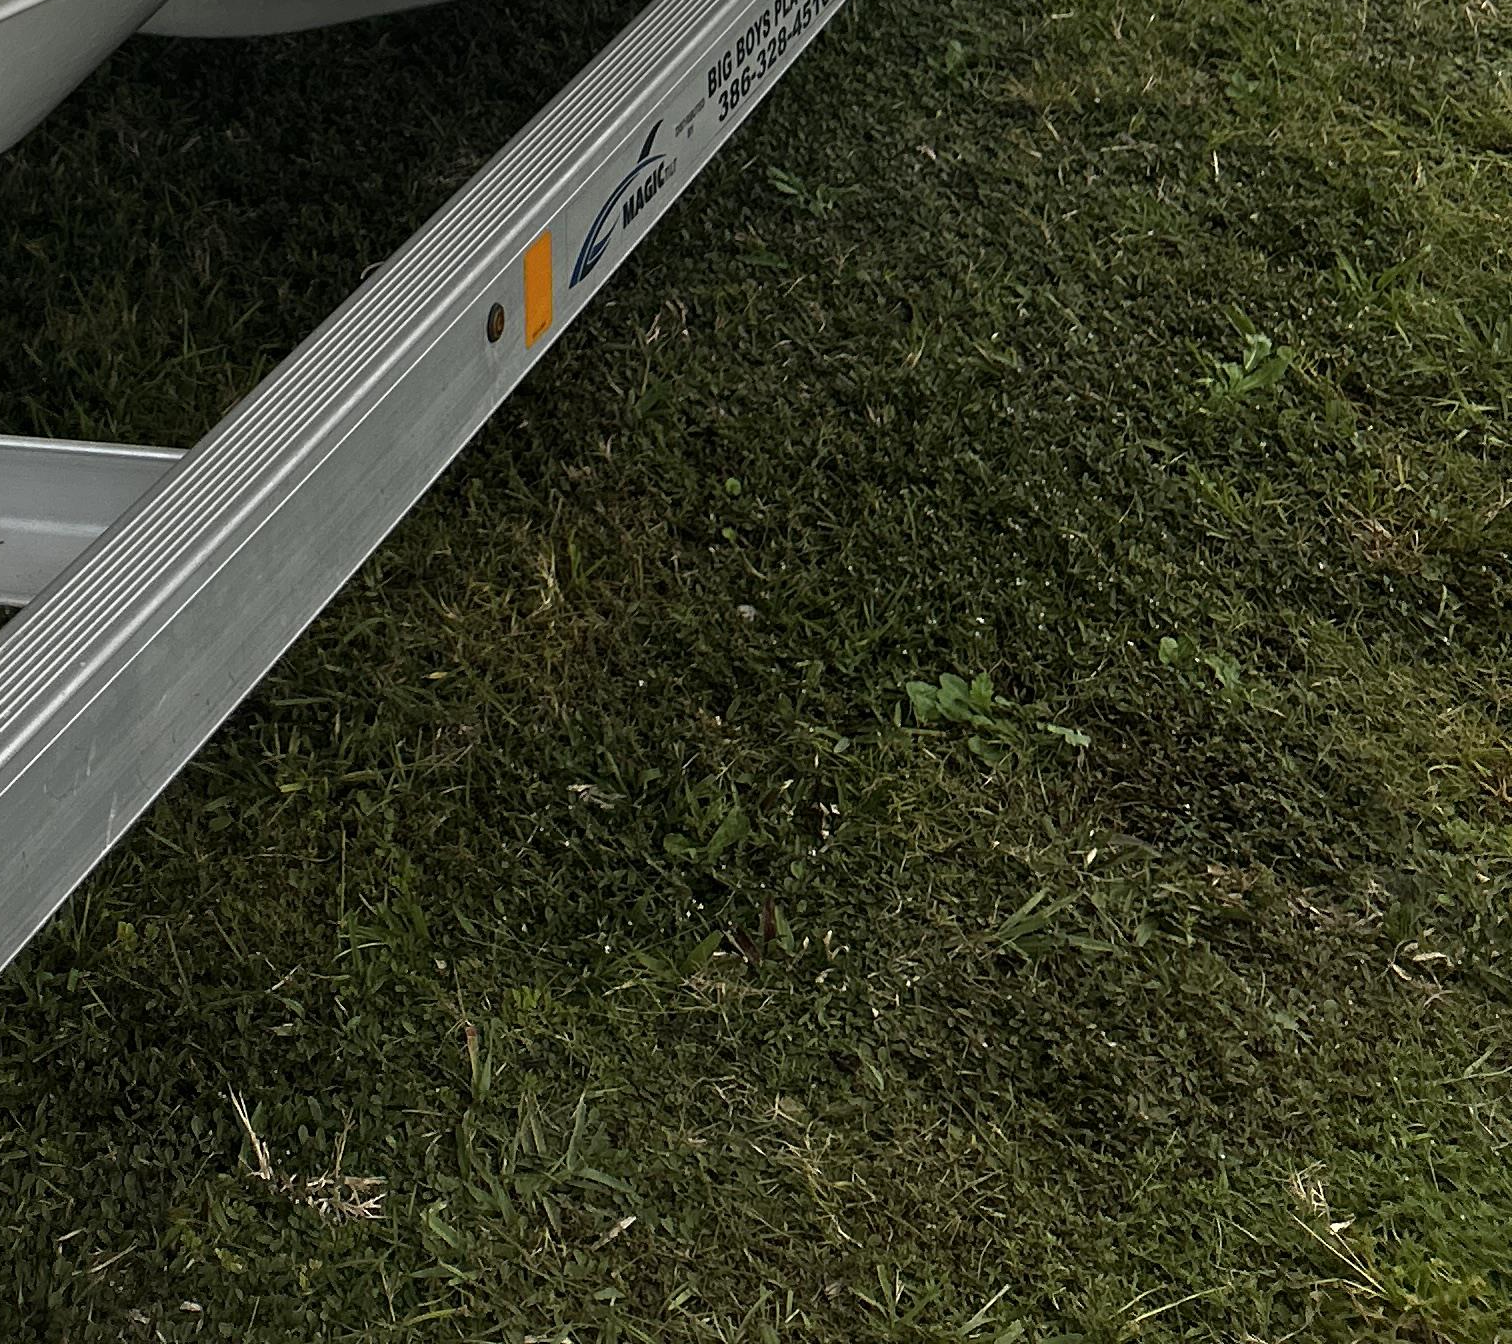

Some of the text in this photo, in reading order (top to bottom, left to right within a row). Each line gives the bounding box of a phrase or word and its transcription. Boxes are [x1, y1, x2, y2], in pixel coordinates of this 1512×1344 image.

[707, 50, 732, 98] BIG
[736, 9, 771, 68] BOYS
[622, 160, 666, 229] MAGIC
